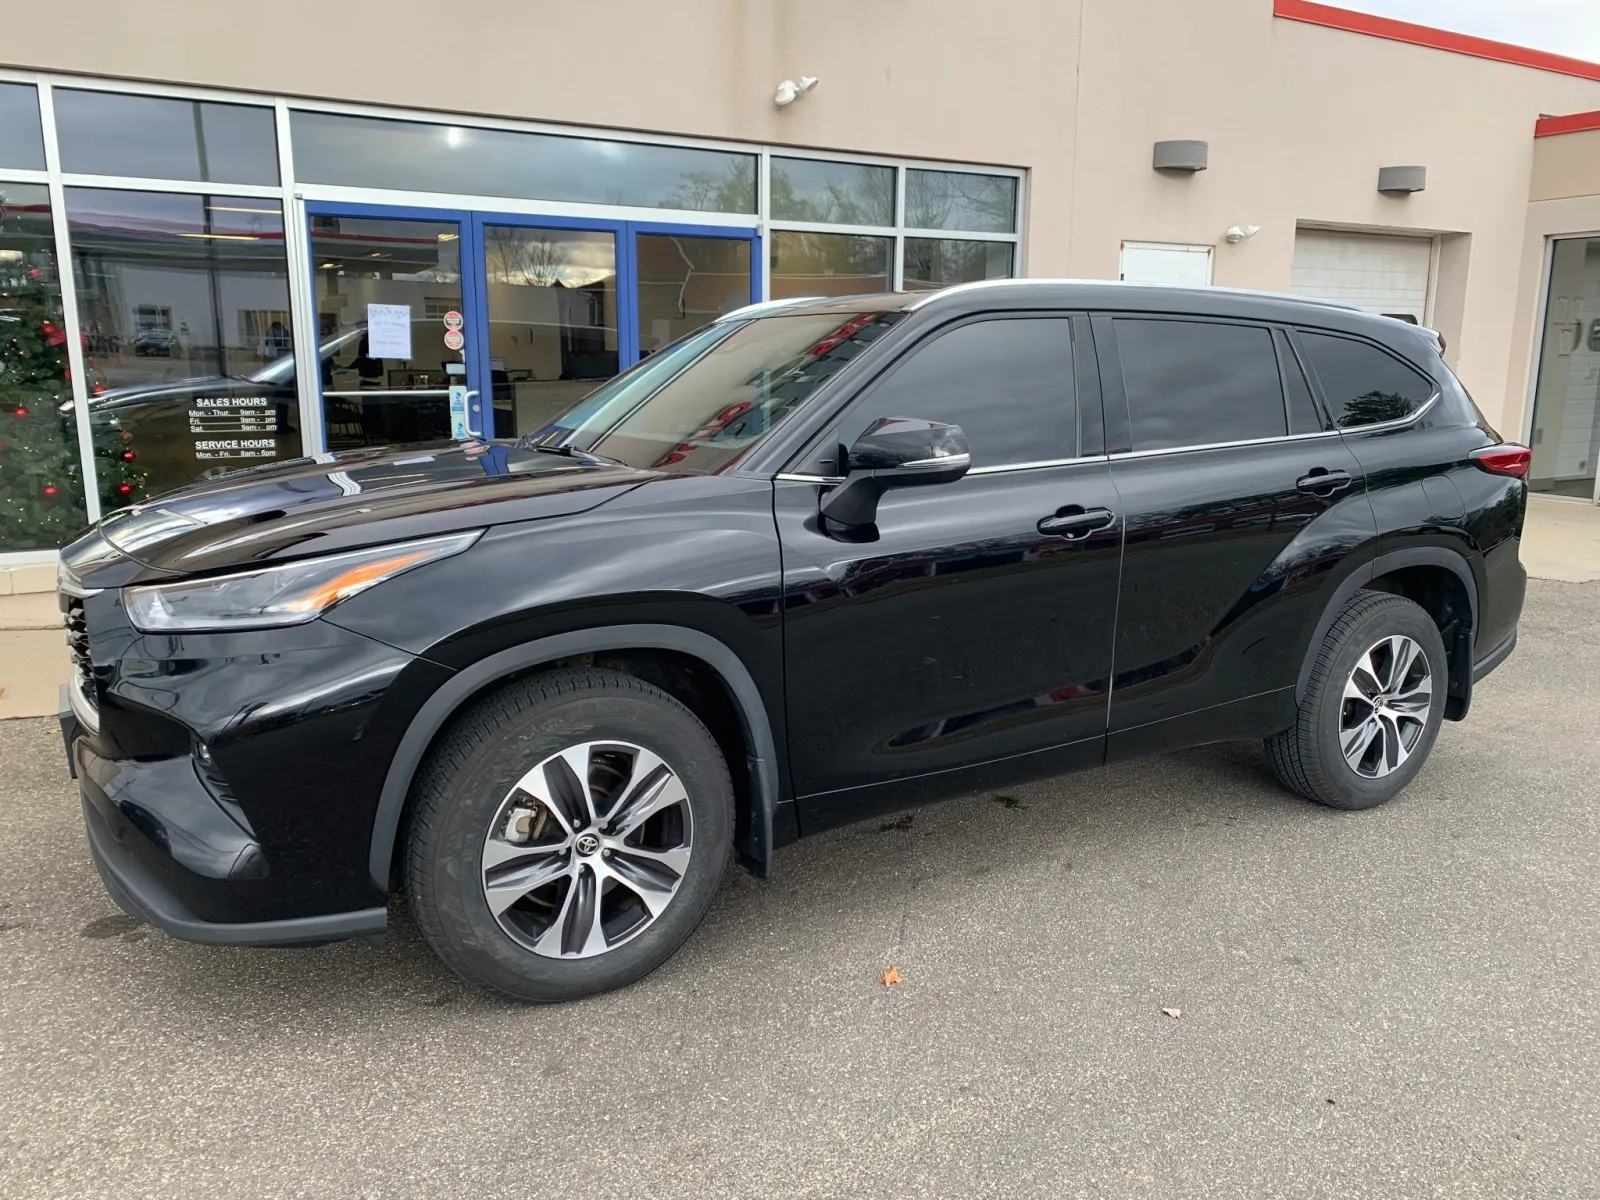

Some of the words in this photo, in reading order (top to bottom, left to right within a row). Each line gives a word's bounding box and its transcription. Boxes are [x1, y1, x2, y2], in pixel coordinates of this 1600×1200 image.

[196, 398, 230, 407] SALES
[231, 397, 267, 406] HOURS
[195, 440, 238, 450] SERVICE
[240, 439, 275, 449] HOURS
